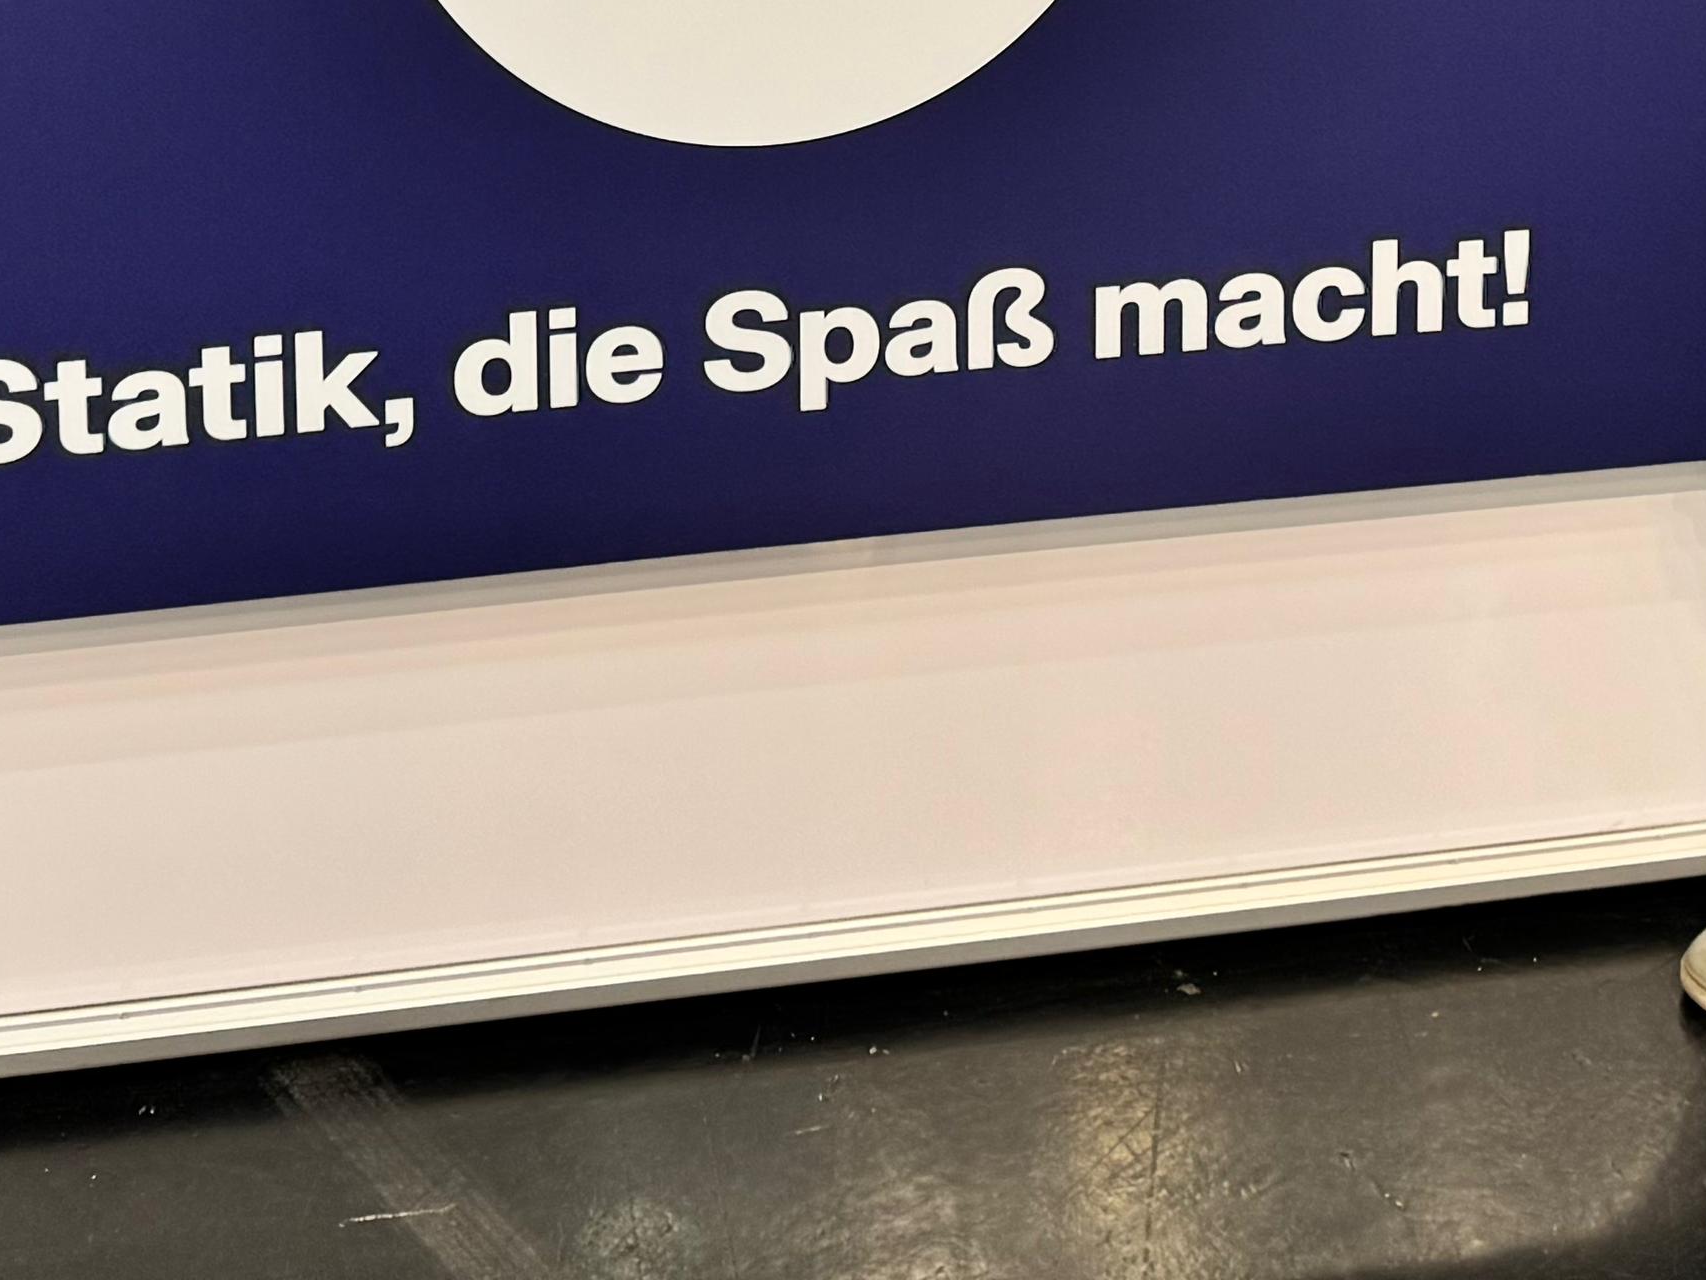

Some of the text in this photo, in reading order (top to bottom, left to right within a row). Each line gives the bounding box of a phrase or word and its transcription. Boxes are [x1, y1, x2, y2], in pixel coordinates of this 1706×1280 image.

[452, 306, 664, 417] die
[702, 267, 1054, 412] Spaß
[1095, 229, 1531, 359] macht!
